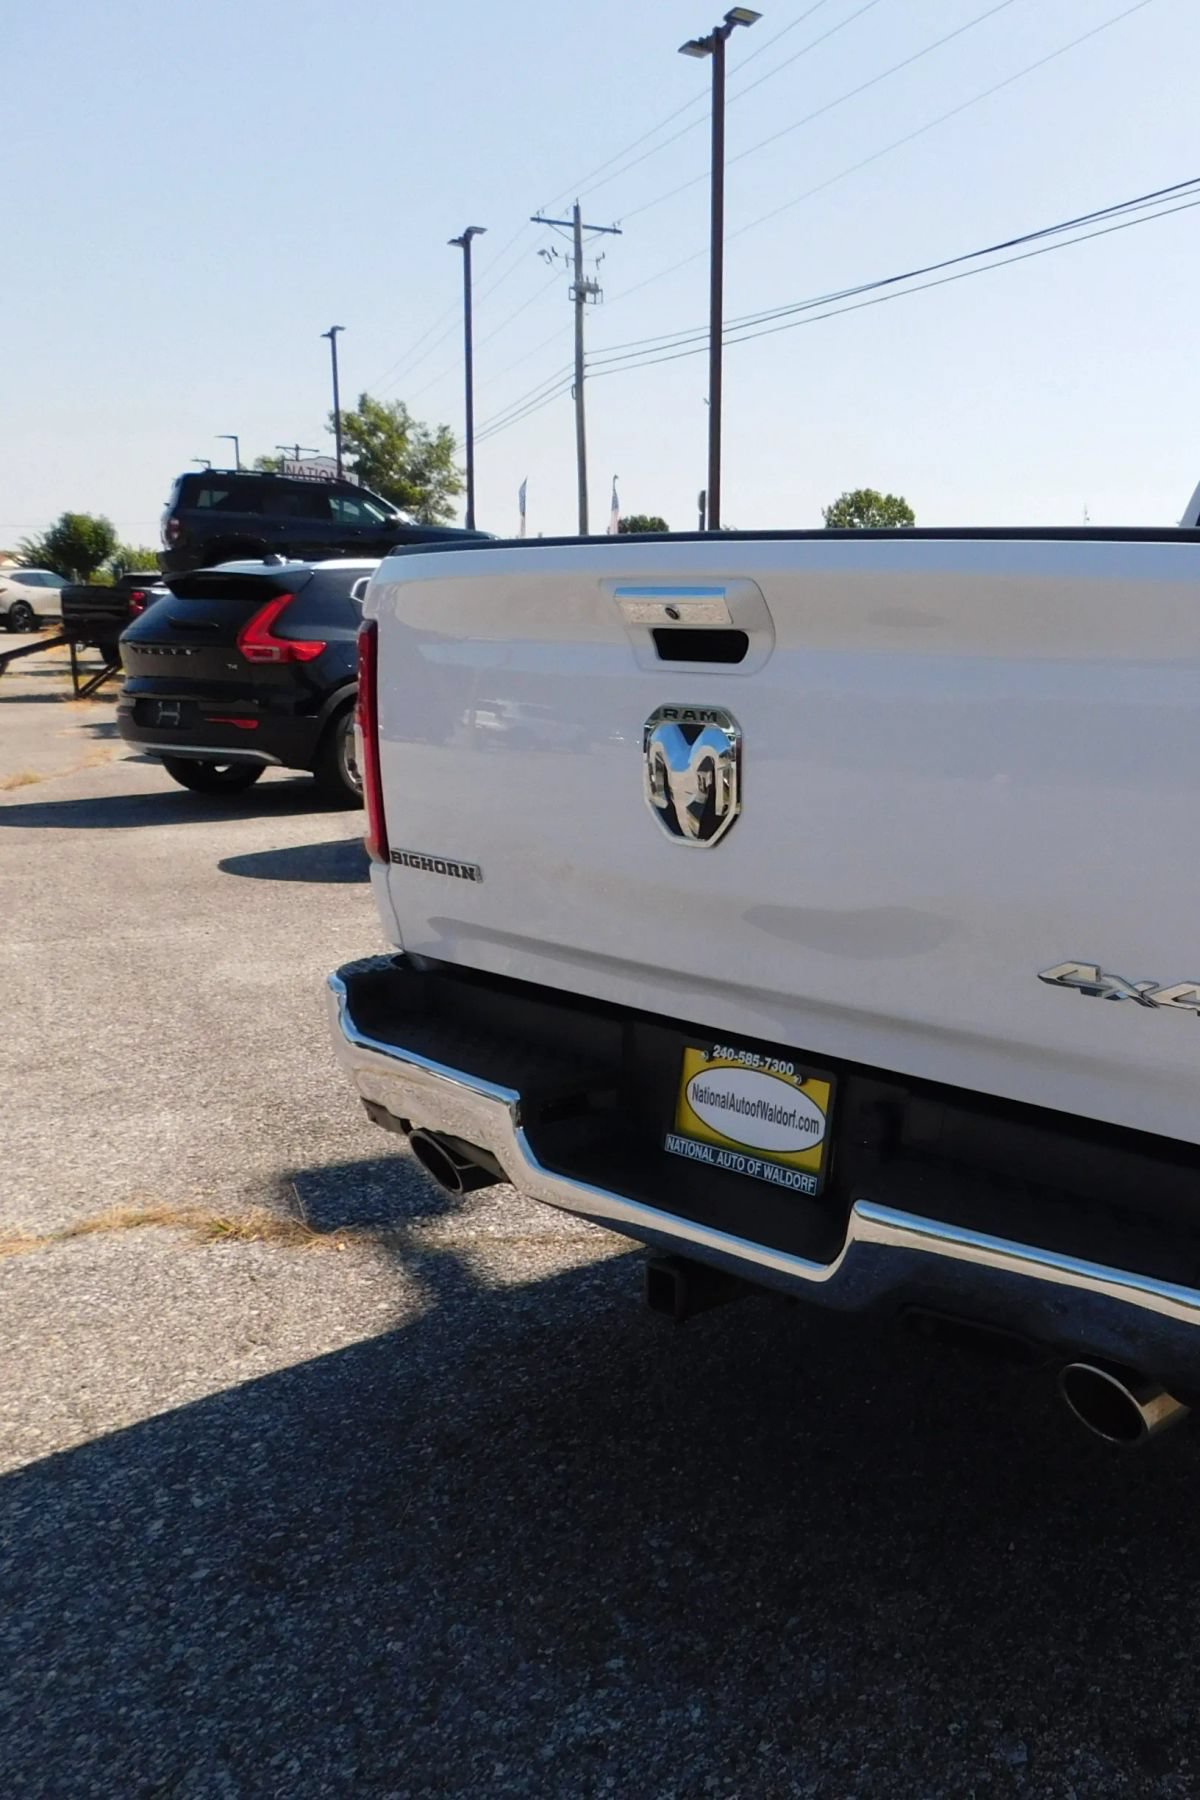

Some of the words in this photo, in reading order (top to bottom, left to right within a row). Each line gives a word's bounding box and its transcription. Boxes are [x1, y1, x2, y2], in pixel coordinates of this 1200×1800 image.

[662, 708, 718, 722] RAM
[390, 850, 477, 881] BIGHORN
[713, 1044, 794, 1077] 240-585-7300
[691, 1082, 820, 1135] NationalAutoofWaldorf.com
[666, 1136, 714, 1163] NATIONAL
[717, 1153, 745, 1172] AUTO
[747, 1159, 761, 1176] OF
[763, 1164, 815, 1193] WALDORF
